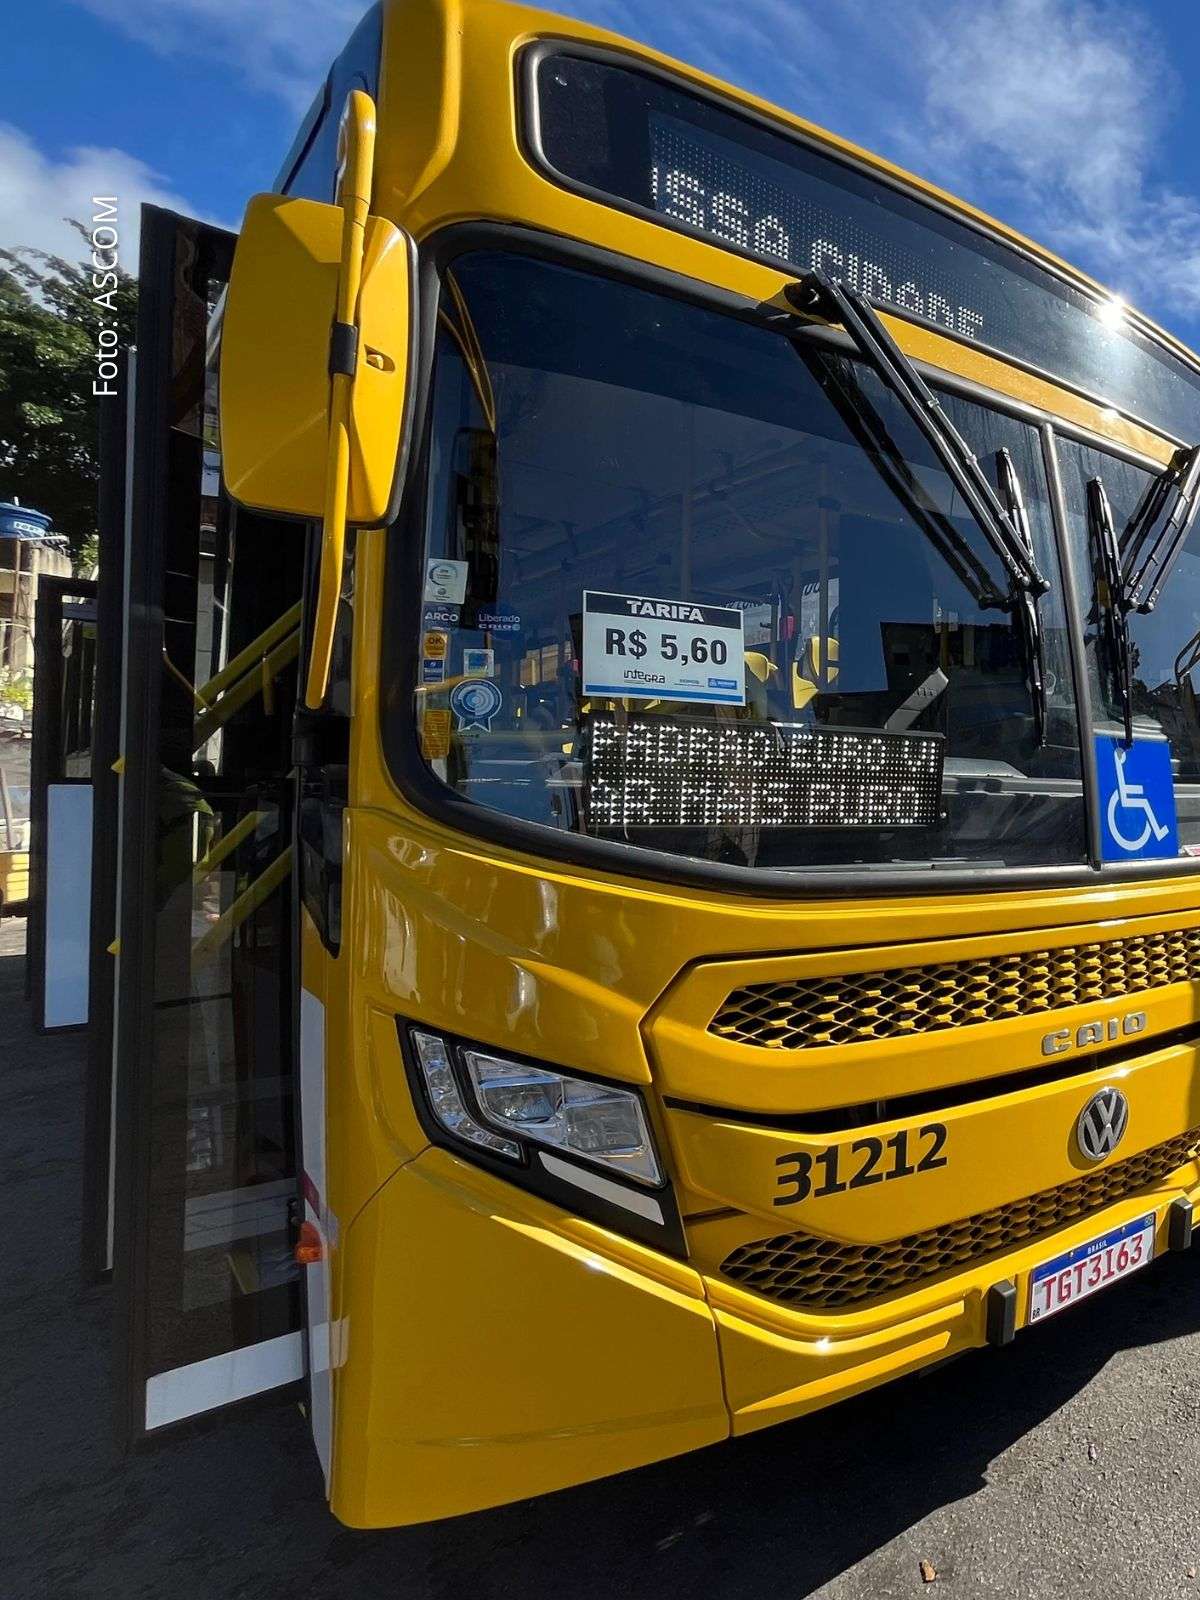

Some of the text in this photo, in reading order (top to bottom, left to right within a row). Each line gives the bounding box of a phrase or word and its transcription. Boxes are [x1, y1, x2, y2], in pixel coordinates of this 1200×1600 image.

[424, 611, 459, 622] ARCO
[478, 613, 521, 623] Liberado
[626, 598, 705, 623] TARIFA
[605, 627, 729, 667] R$ 5,60
[1041, 1010, 1148, 1057] CAIO
[772, 1121, 949, 1208] 31212
[1087, 1239, 1108, 1255] BRASIL
